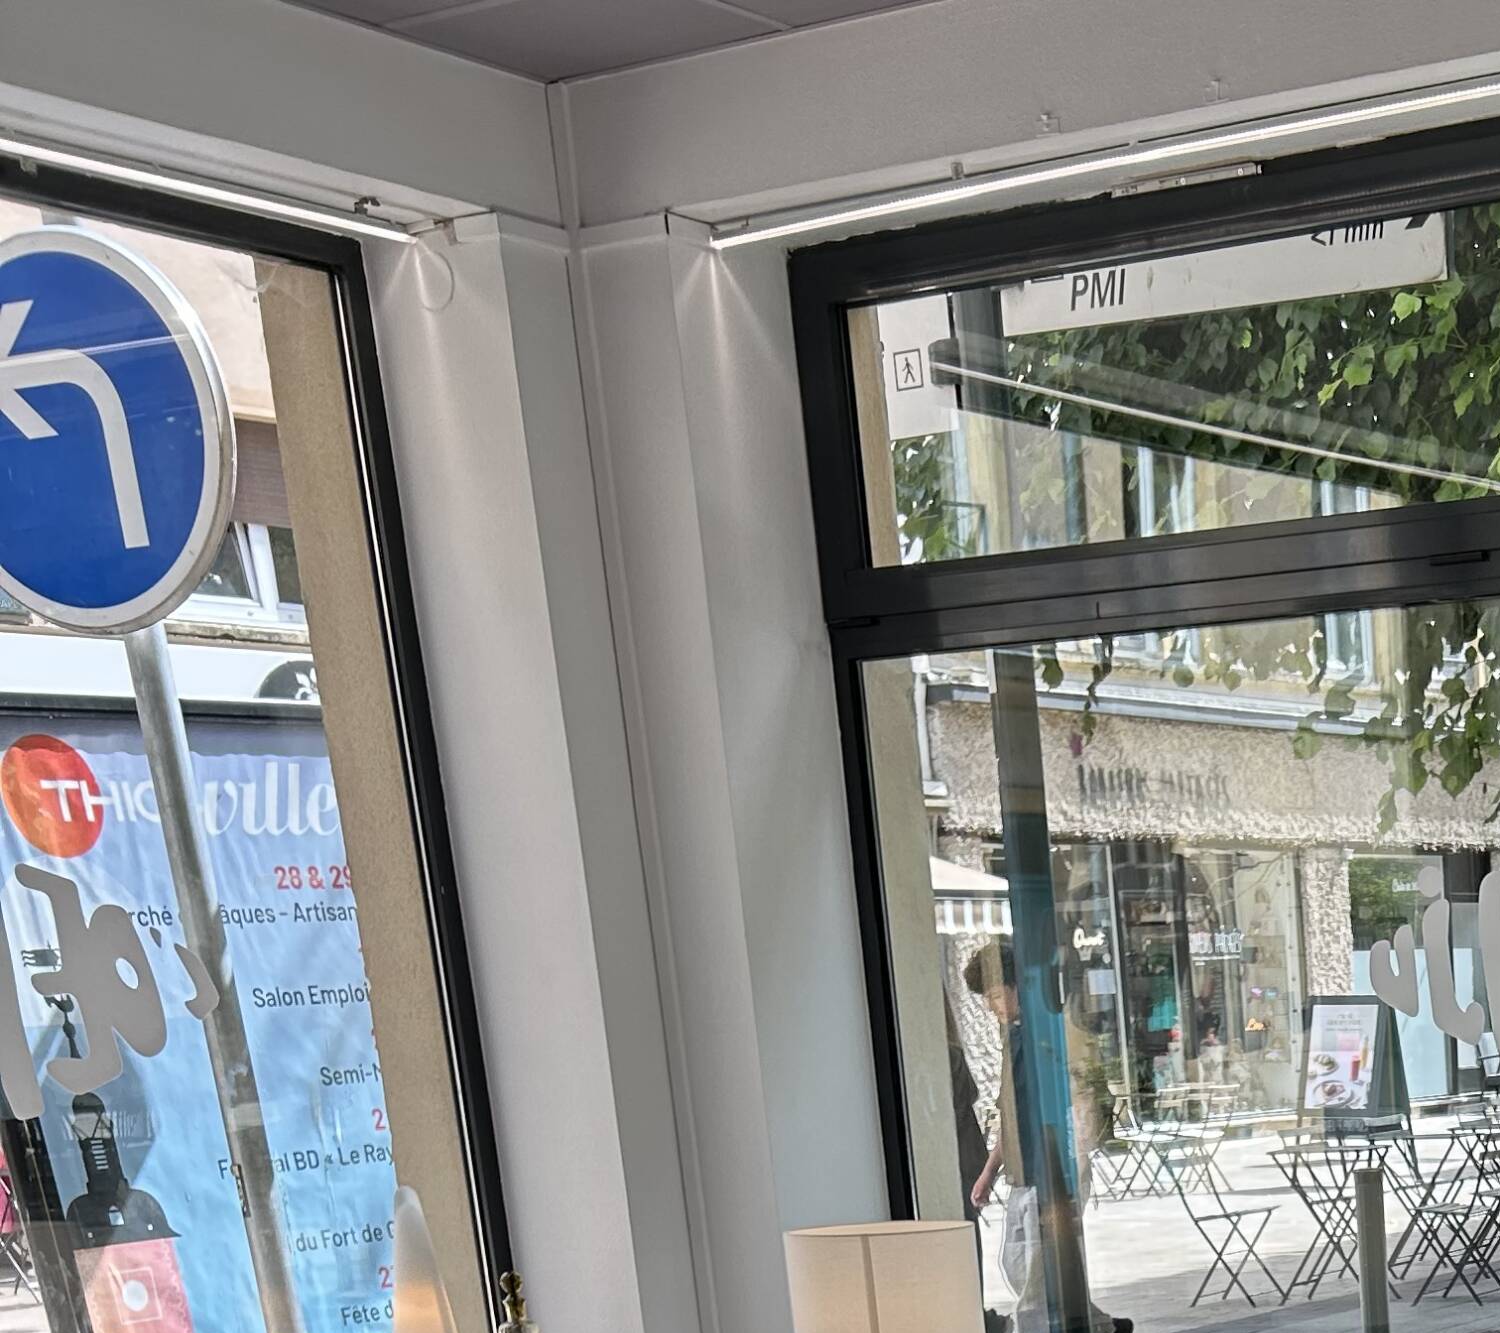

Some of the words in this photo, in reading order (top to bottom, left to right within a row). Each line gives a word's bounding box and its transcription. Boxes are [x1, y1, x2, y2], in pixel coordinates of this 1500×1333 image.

[1070, 268, 1127, 311] PMI
[274, 865, 303, 890] 28
[308, 865, 325, 890] &
[252, 984, 306, 1009] Salon
[307, 981, 371, 1008] Emploi
[293, 1149, 320, 1172] BD
[337, 1146, 361, 1166] Le
[295, 1232, 320, 1252] du
[321, 1226, 359, 1249] Fort
[362, 1223, 384, 1244] de
[340, 1304, 381, 1327] Fête
